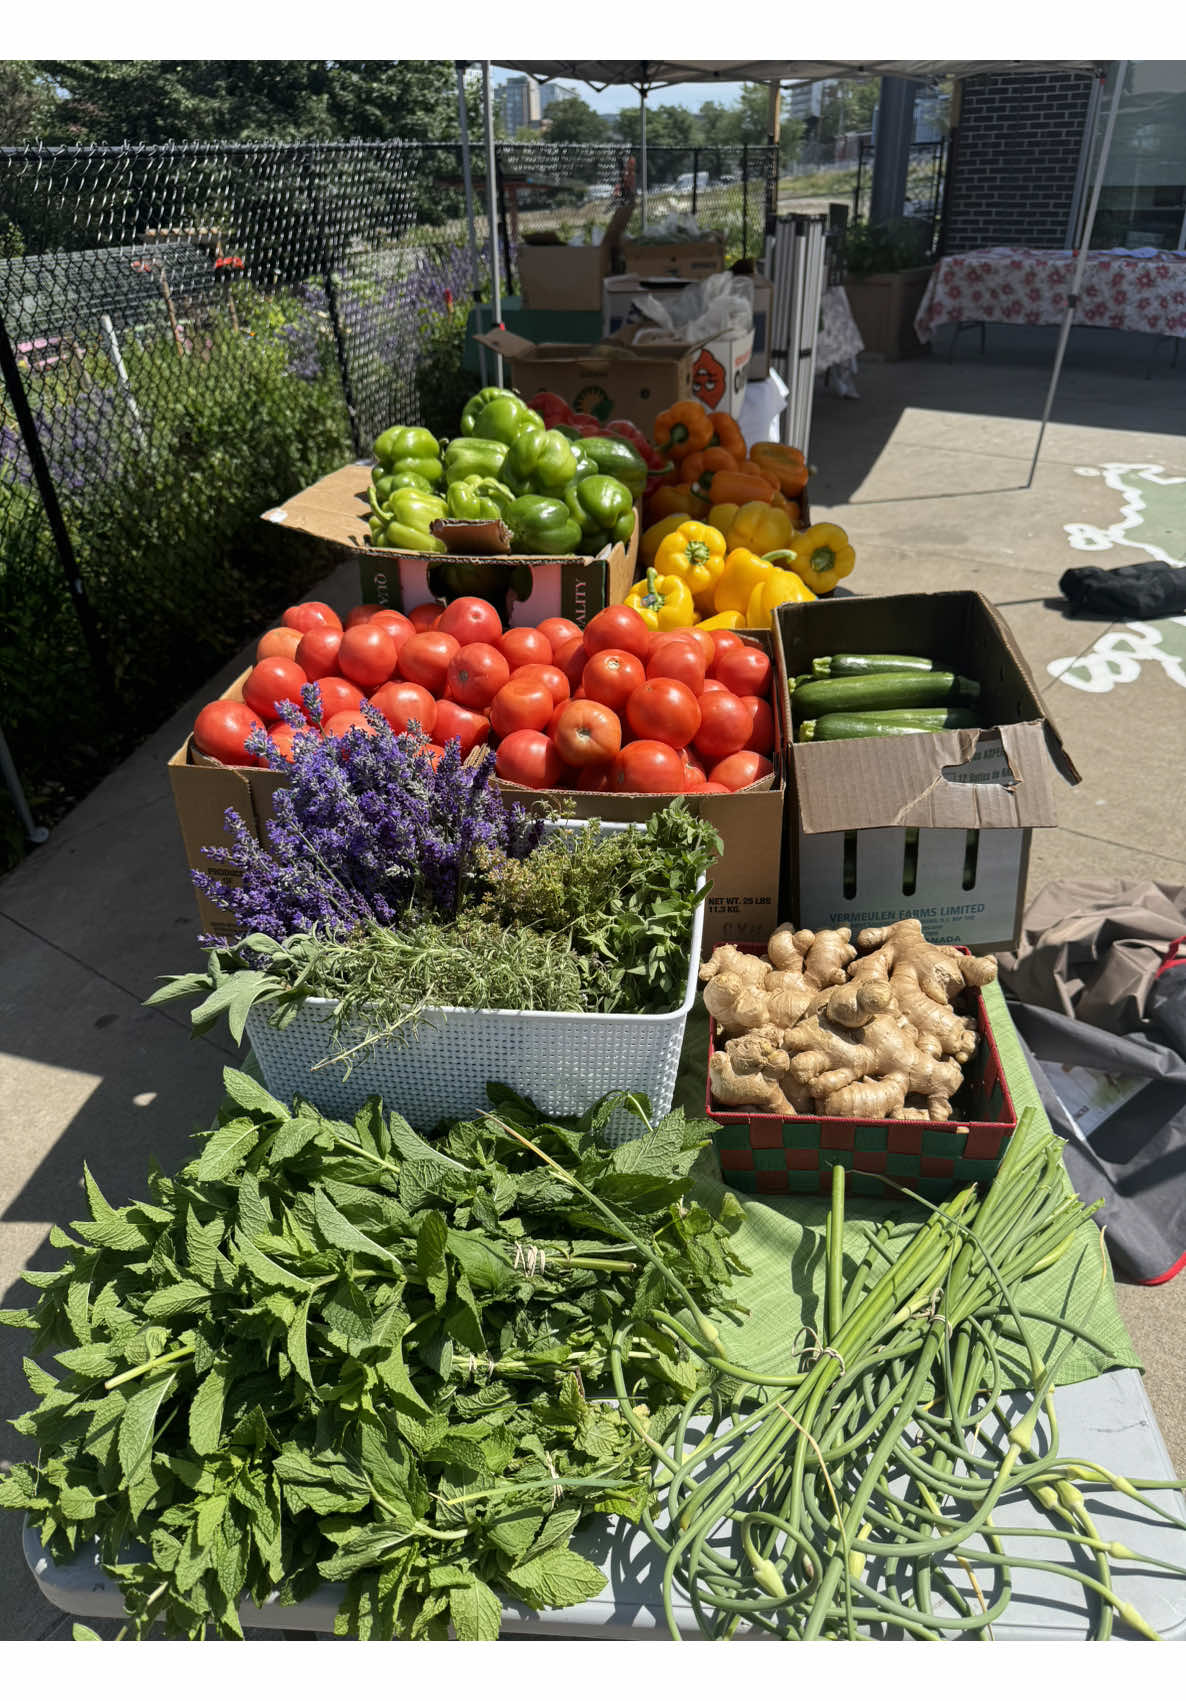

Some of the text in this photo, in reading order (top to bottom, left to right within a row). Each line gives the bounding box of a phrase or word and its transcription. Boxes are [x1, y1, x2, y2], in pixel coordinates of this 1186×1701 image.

[575, 578, 587, 627] ALITY
[708, 897, 726, 905] NET
[726, 897, 742, 905] WT.
[755, 897, 772, 905] LBS
[830, 911, 896, 923] VERMEULEN
[898, 907, 937, 919] FARMS
[940, 903, 985, 916] LIMITED
[928, 935, 961, 943] ANADA
